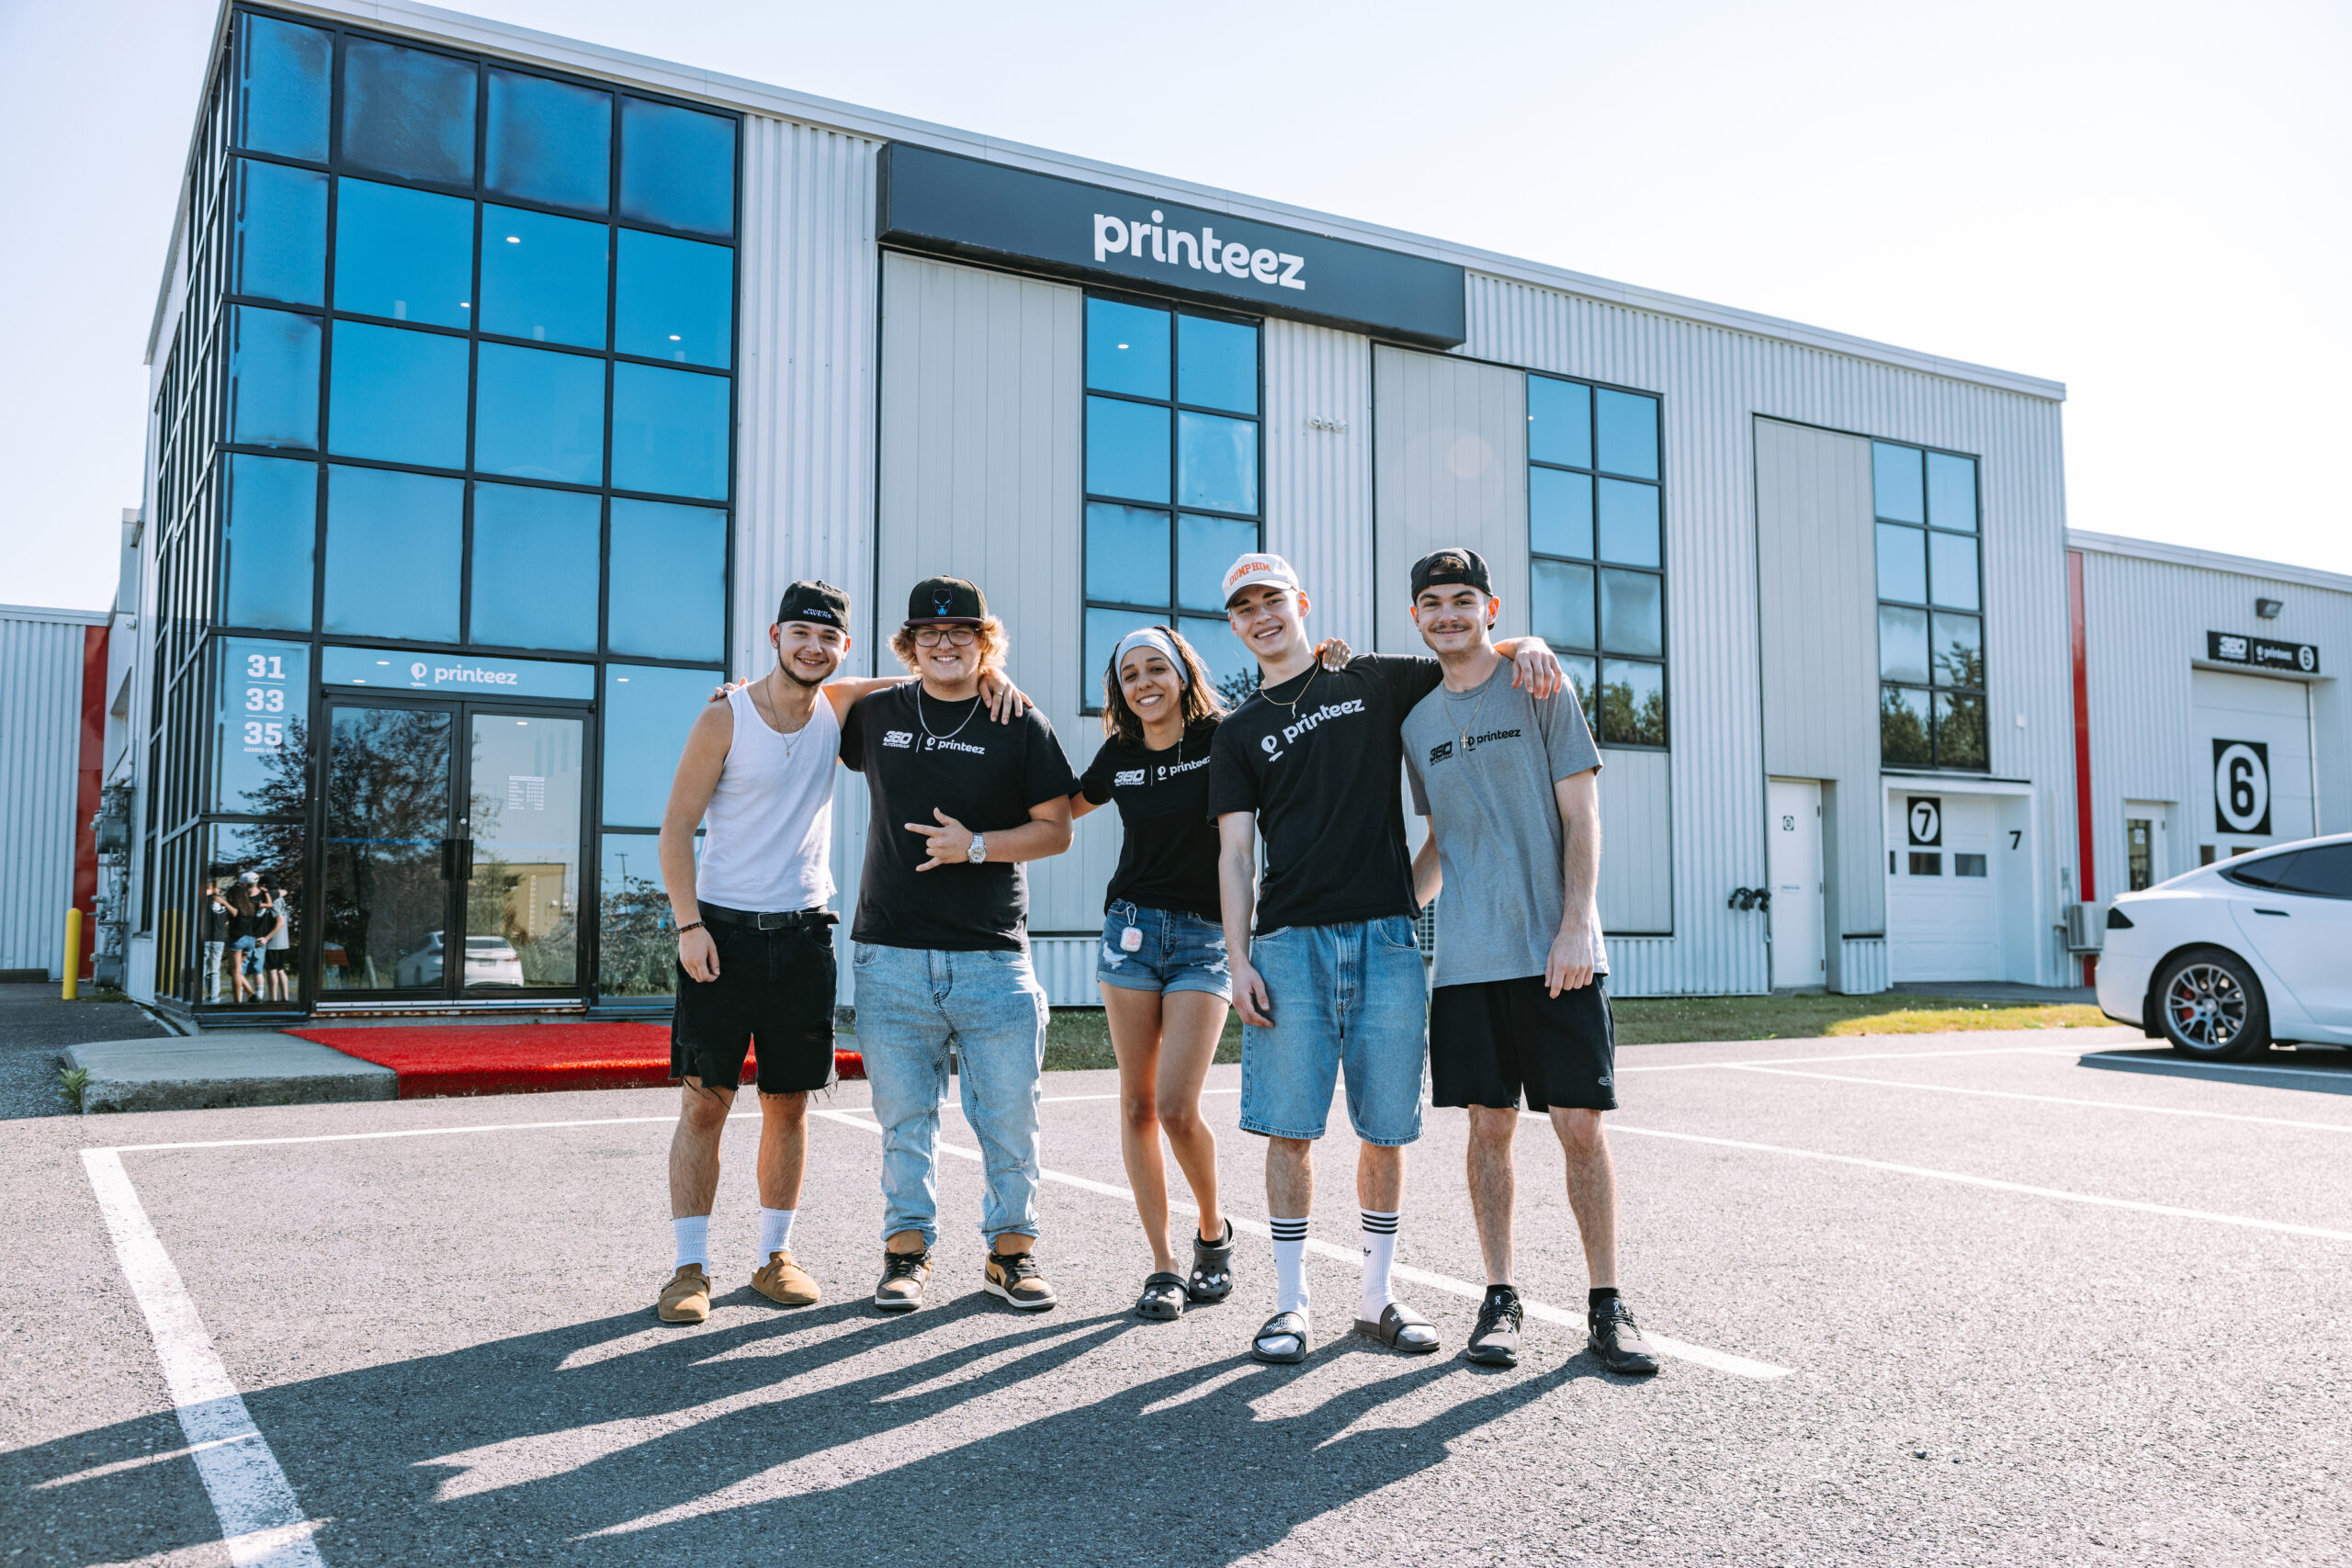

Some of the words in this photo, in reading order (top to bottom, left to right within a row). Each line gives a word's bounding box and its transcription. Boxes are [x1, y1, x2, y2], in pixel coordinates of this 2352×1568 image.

[1093, 209, 1306, 291] printeez
[1228, 563, 1251, 586] DUMP
[1251, 561, 1272, 572] HIM
[2219, 636, 2247, 655] 360
[2303, 649, 2311, 665] 6
[247, 654, 286, 679] 31
[435, 664, 517, 685] printeez
[245, 688, 285, 713] 33
[243, 721, 283, 746] 35
[1282, 698, 1365, 744] printeez
[883, 730, 913, 745] 360
[937, 739, 985, 755] printeez
[1430, 740, 1453, 762] 360
[1476, 729, 1521, 746] printeez
[1114, 769, 1146, 784] 360
[2230, 757, 2255, 818] 6
[1917, 809, 1931, 837] 7
[2009, 830, 2021, 851] 7
